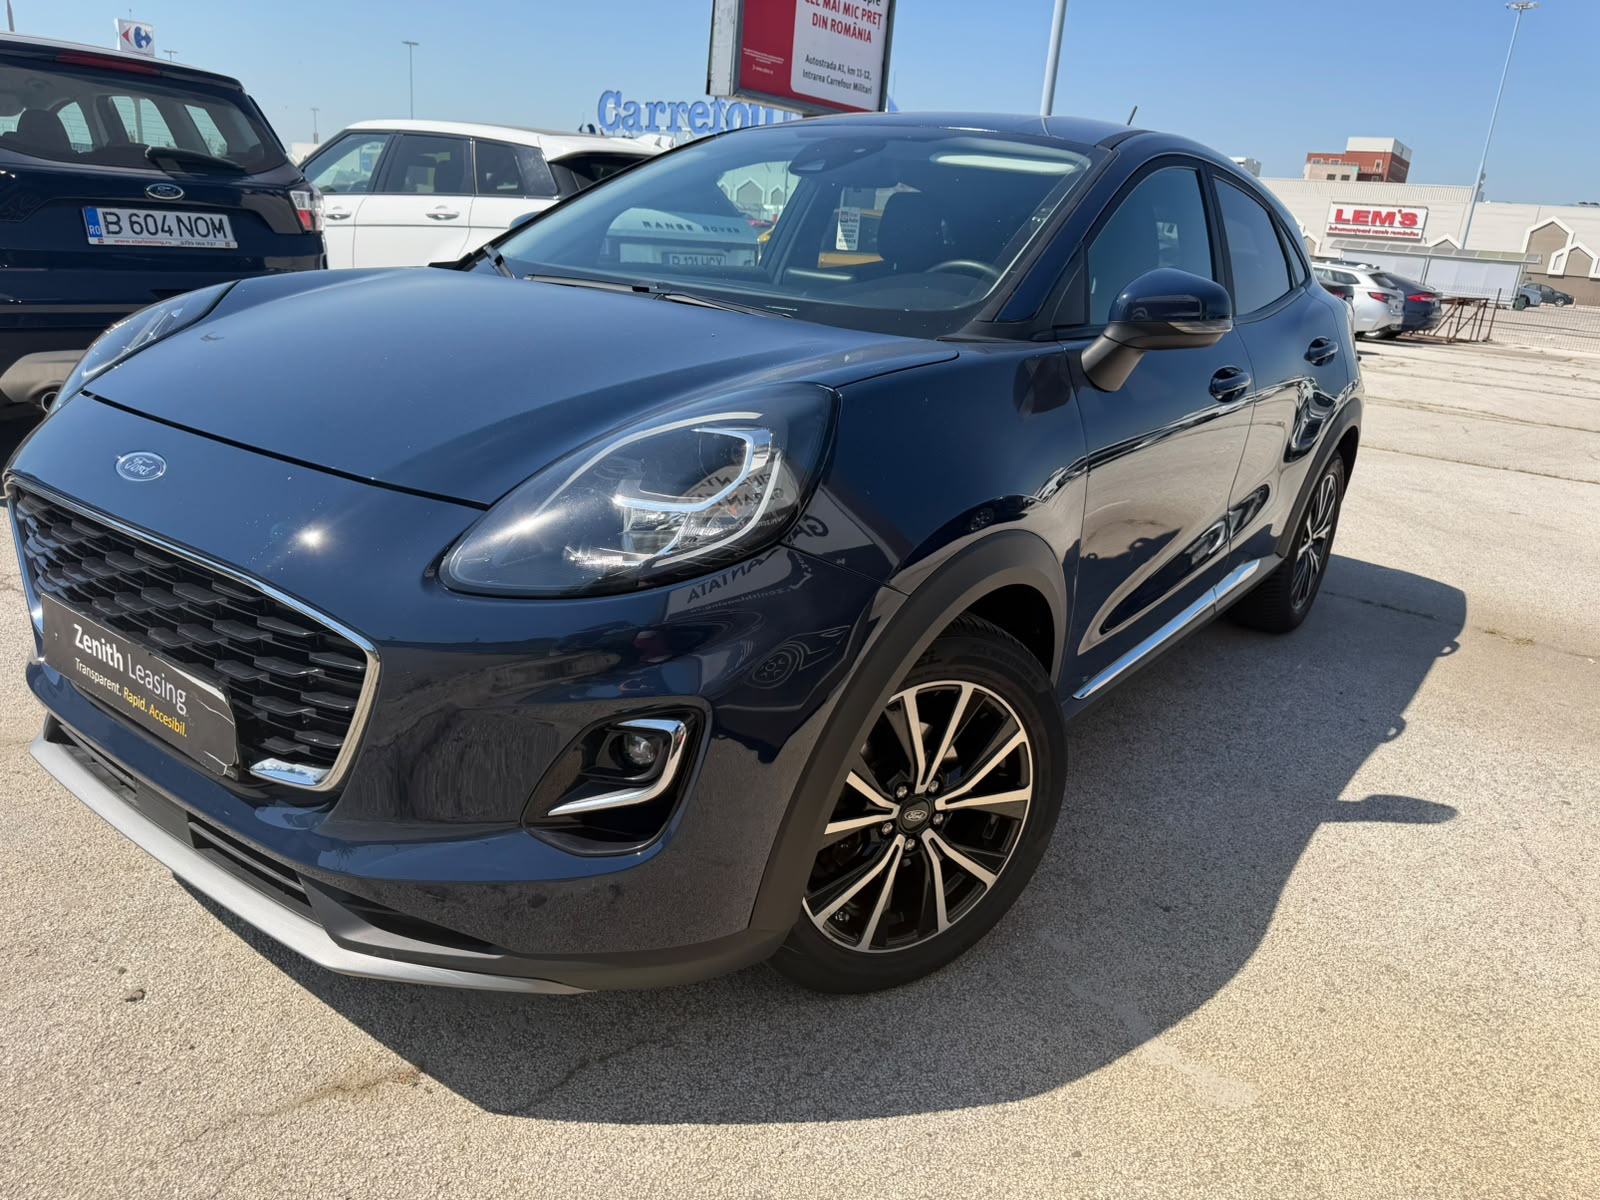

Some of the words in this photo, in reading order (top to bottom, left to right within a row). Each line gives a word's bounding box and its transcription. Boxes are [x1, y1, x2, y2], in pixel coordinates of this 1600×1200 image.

[842, 2, 860, 20] MIC
[812, 12, 828, 30] DIN
[830, 18, 872, 43] ROMÂNIA
[805, 54, 837, 71] Autostrada
[847, 65, 856, 76] km
[802, 69, 826, 83] Intrarea
[826, 75, 852, 90] Carrefour
[852, 82, 873, 95] Militari
[598, 90, 797, 134] Carrefou
[89, 225, 101, 235] RO
[103, 211, 123, 235] B
[128, 213, 173, 237] 604
[176, 215, 227, 239] NOM
[642, 220, 694, 231] RANGE
[702, 225, 740, 233] ROVER
[1335, 208, 1418, 228] LEM'S
[122, 454, 159, 477] Ford
[73, 624, 124, 672] Zenith
[128, 653, 187, 716] Leasing
[75, 657, 122, 696] Transparent.
[123, 686, 147, 713] Rapid.
[149, 704, 187, 737] Accesibil.
